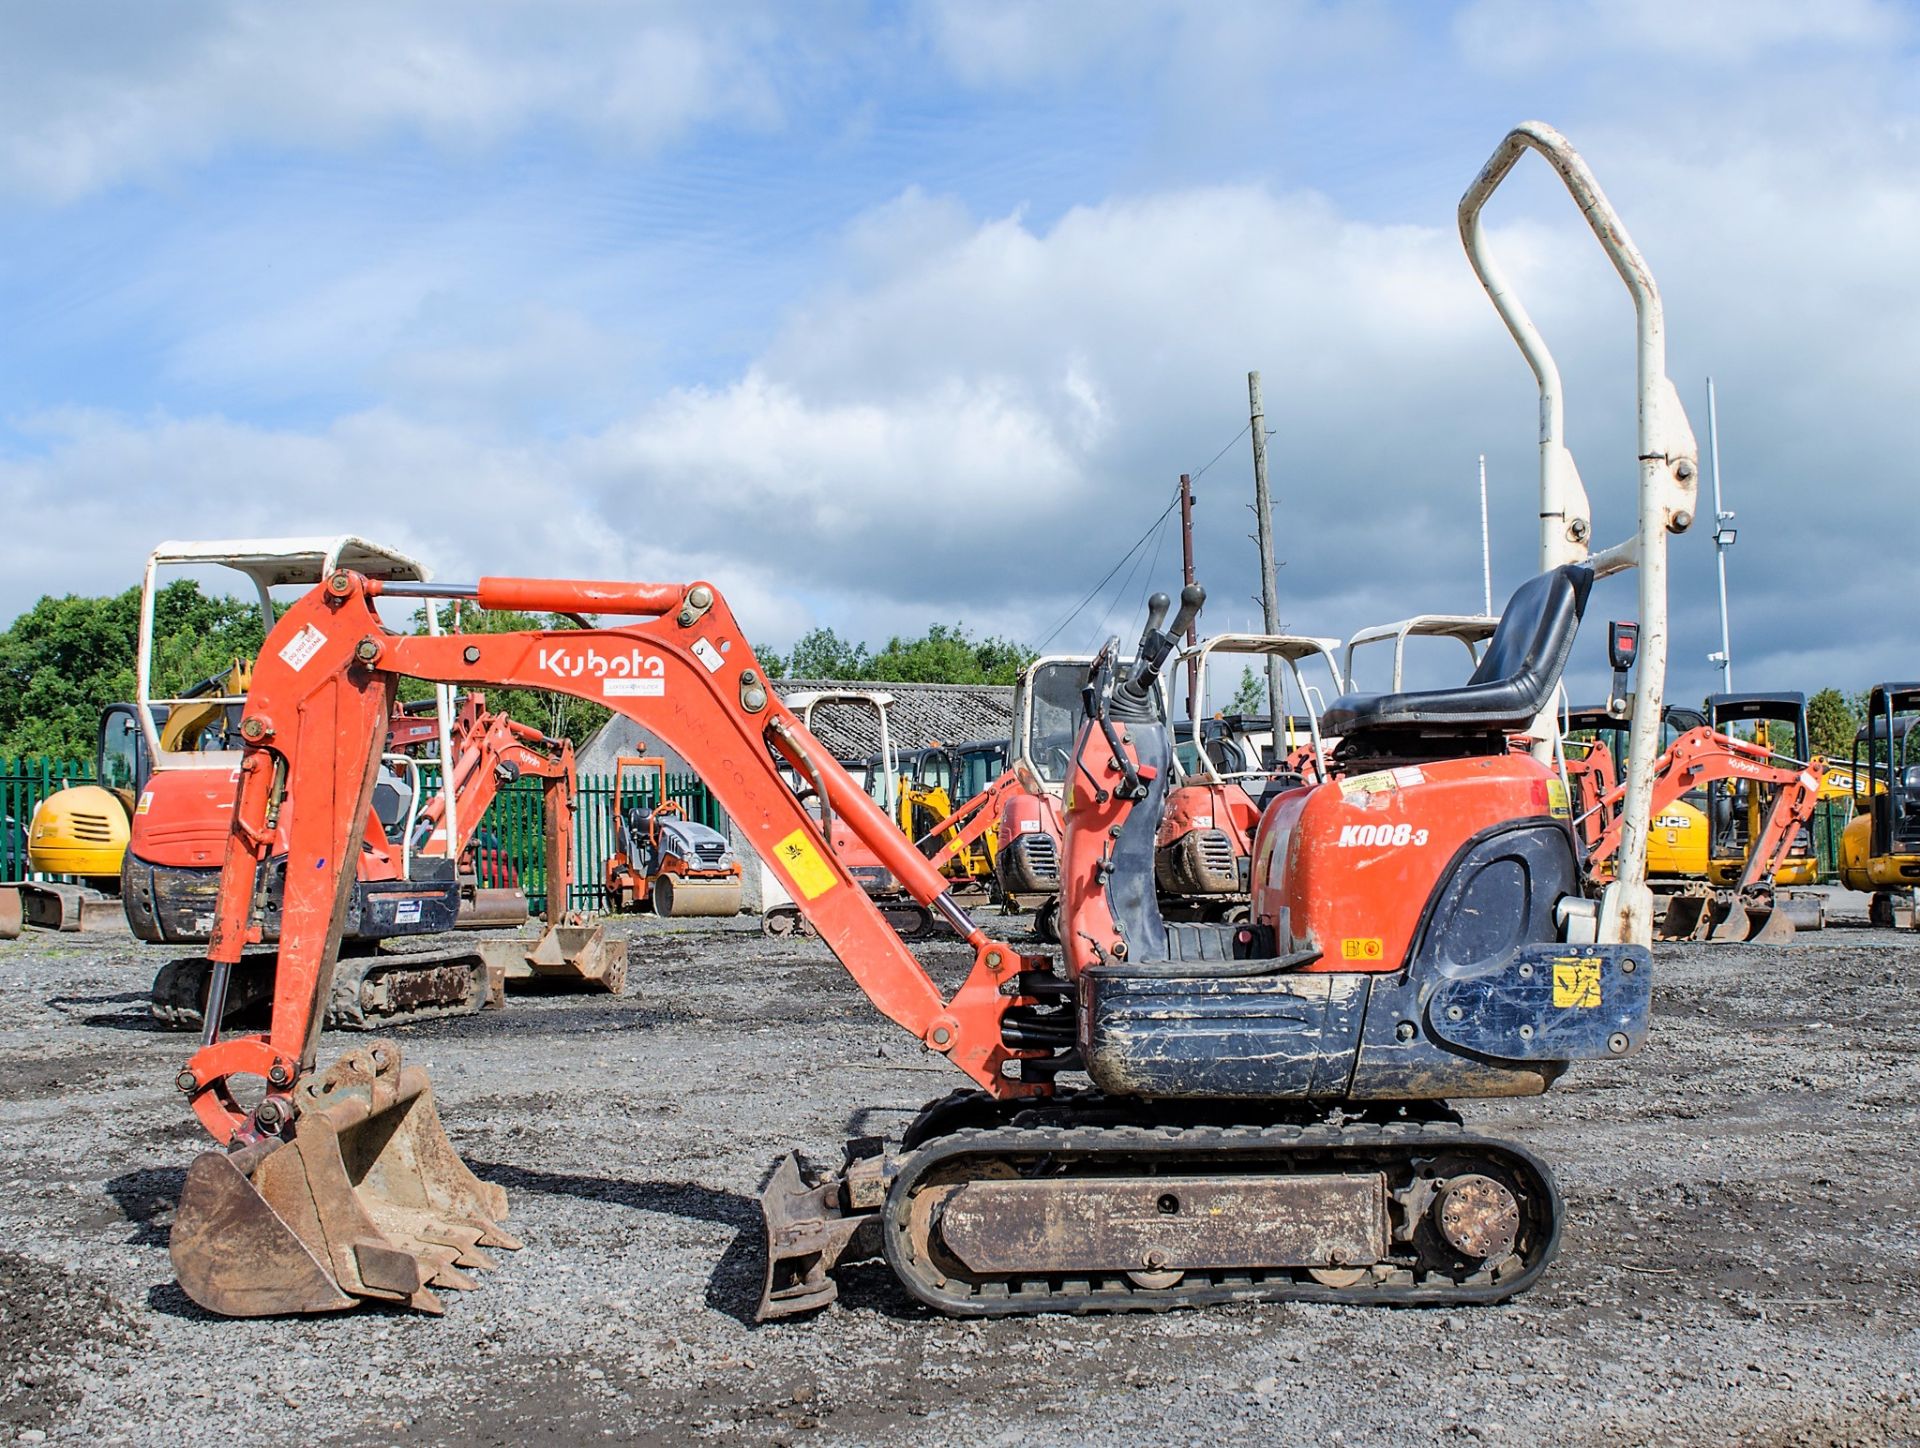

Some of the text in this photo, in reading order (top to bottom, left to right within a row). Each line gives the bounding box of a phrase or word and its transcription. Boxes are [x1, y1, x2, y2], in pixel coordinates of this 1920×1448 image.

[539, 649, 665, 677] Kubota
[519, 750, 540, 768] Kubota
[1728, 758, 1760, 774] Kubota
[1828, 774, 1866, 792] JCB
[1655, 816, 1691, 829] JCB
[1338, 823, 1429, 848] K008-3
